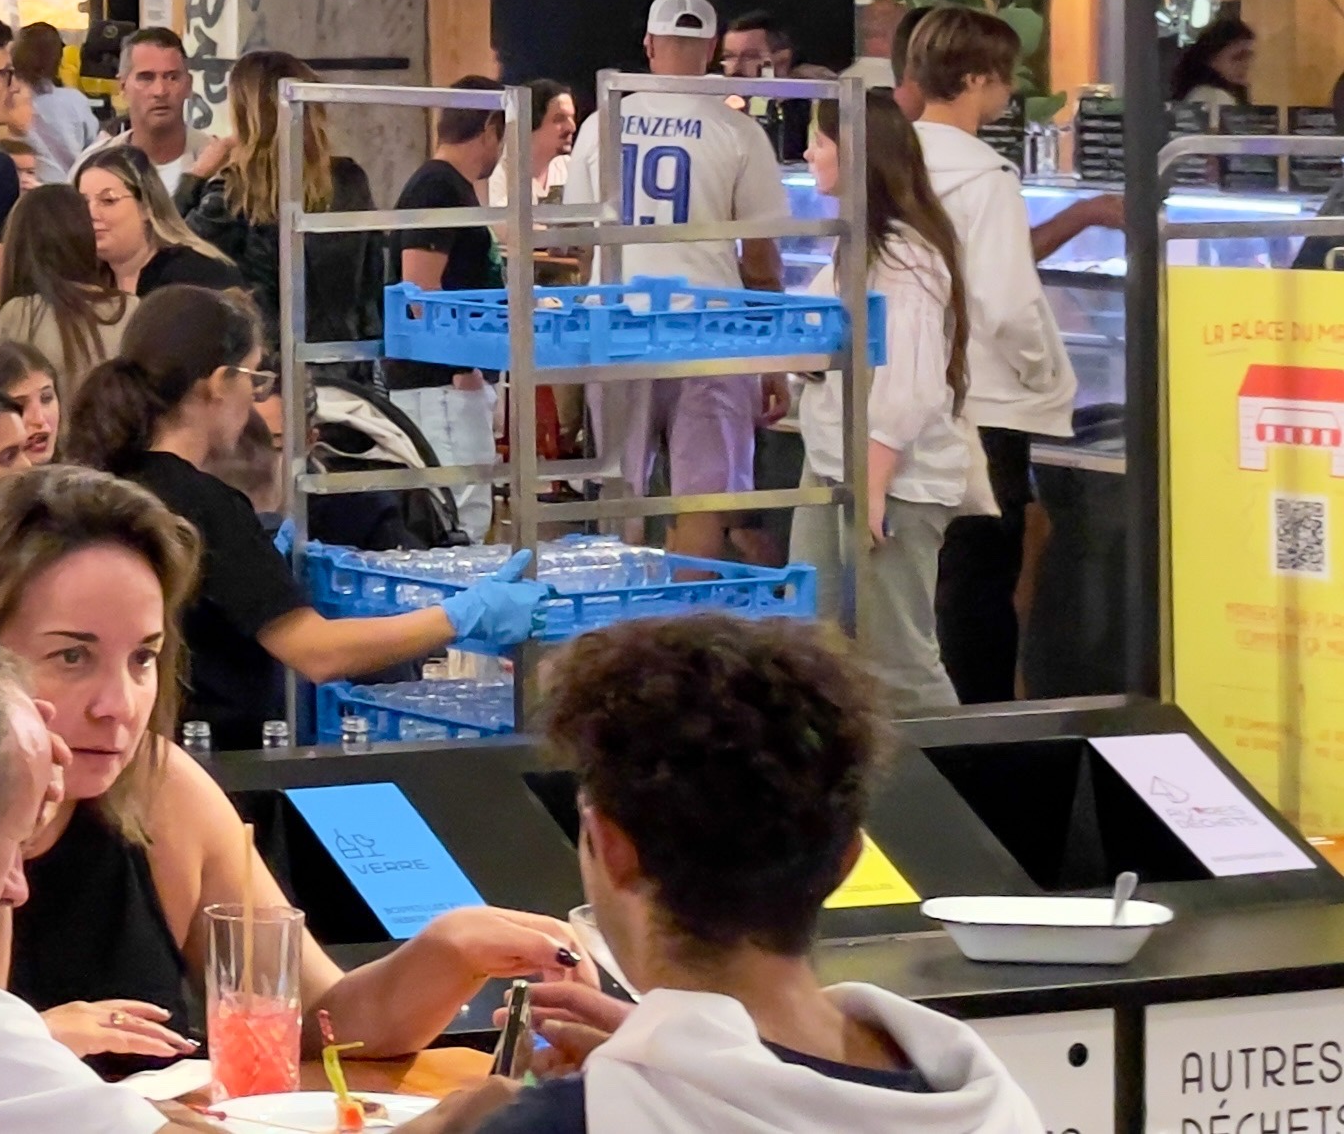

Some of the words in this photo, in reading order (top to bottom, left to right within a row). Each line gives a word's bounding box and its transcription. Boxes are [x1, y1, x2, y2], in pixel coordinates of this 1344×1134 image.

[621, 115, 702, 139] ENZEMA
[621, 143, 691, 225] 19
[350, 858, 431, 875] VERRE
[1181, 1040, 1343, 1095] AUTRES
